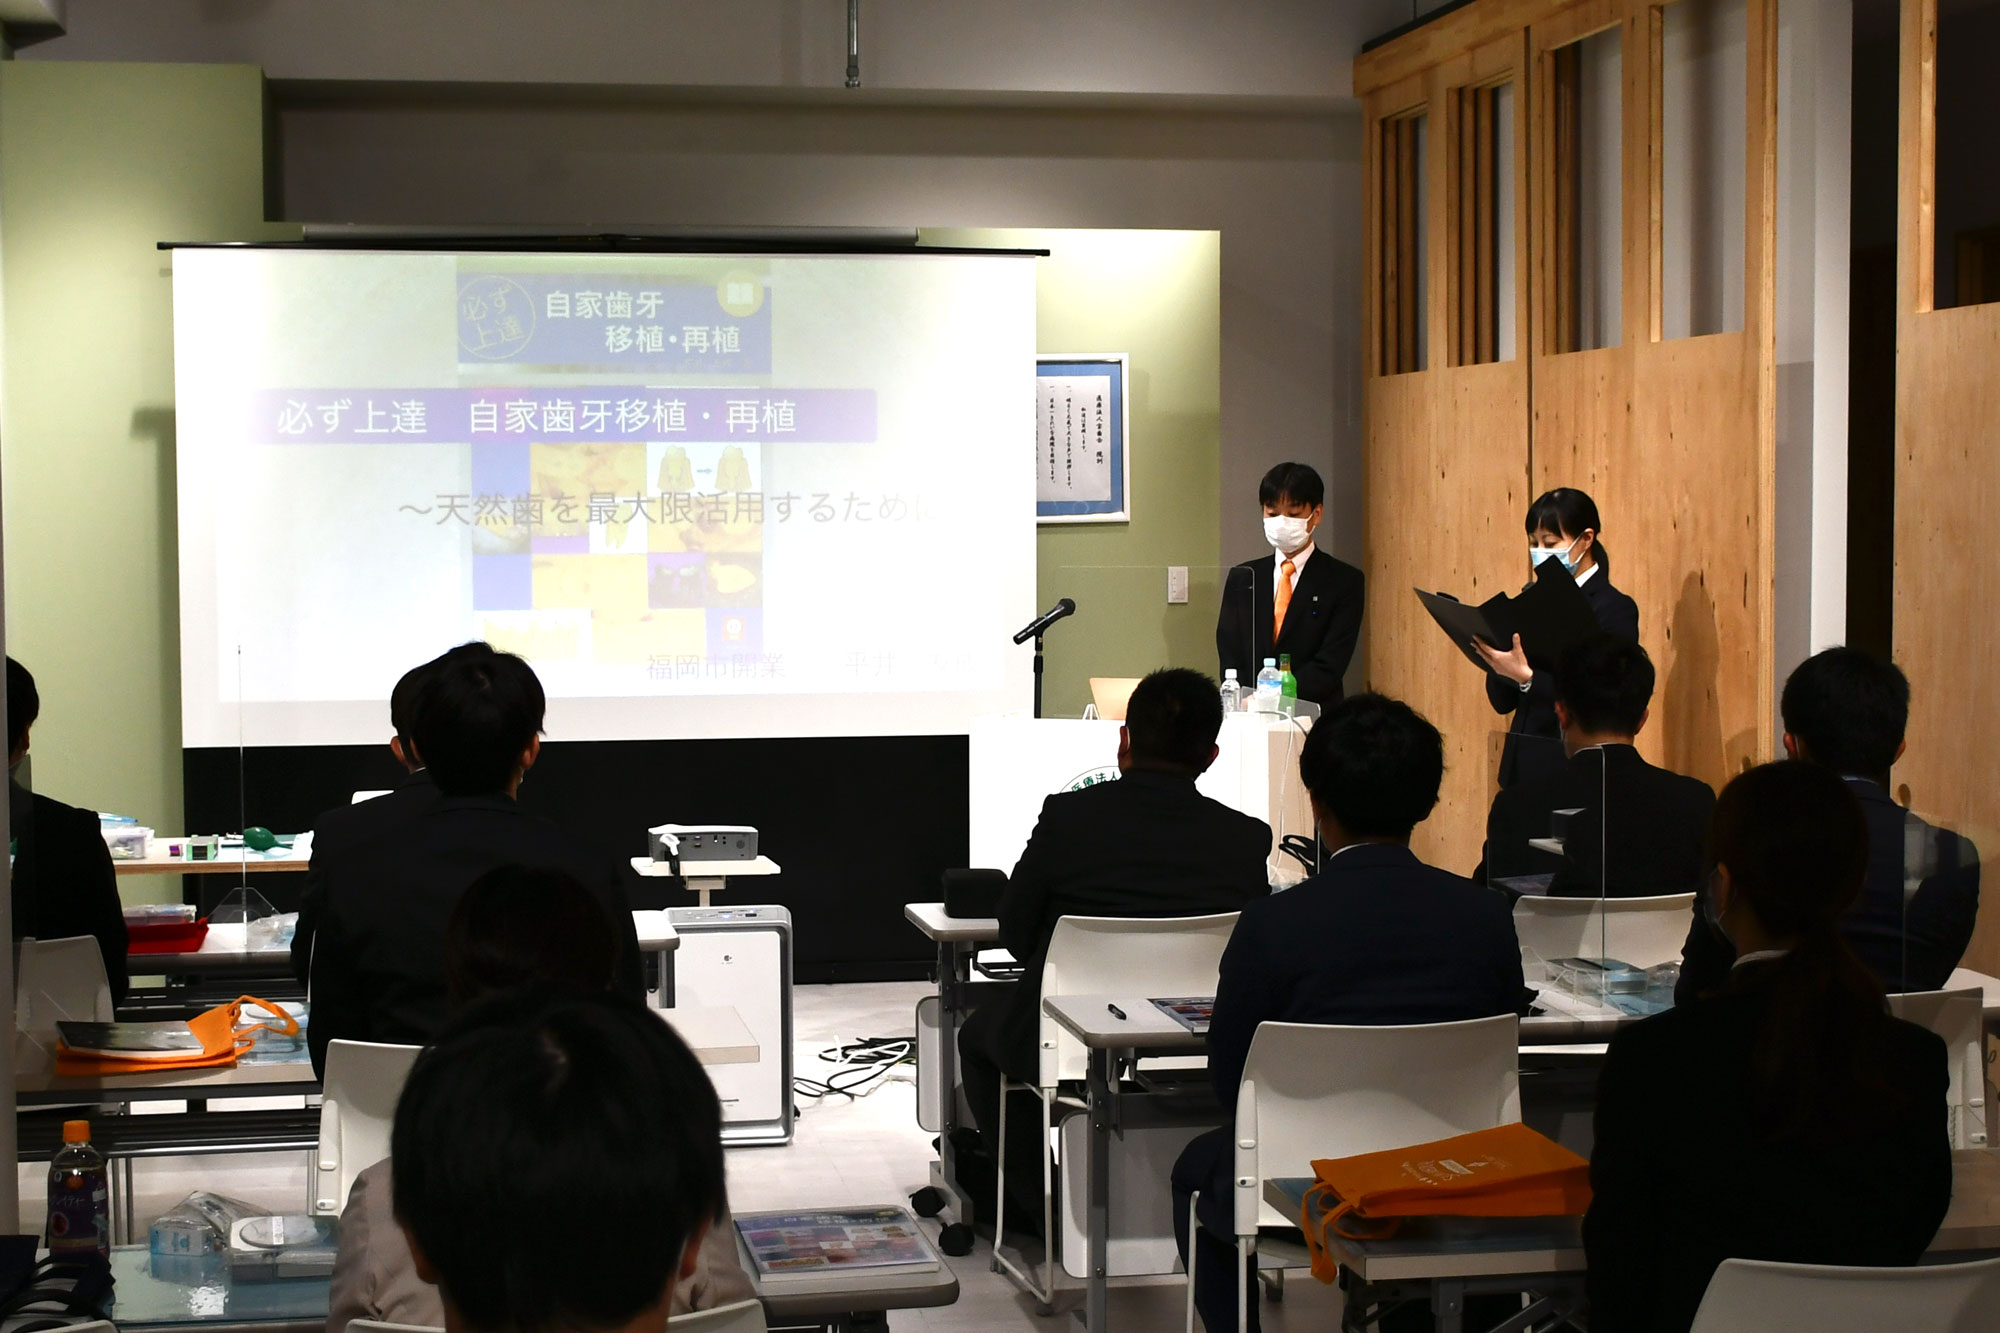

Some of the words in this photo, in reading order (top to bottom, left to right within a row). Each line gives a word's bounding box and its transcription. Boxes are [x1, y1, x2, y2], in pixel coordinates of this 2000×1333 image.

[546, 290, 664, 319] 自家歯牙
[277, 399, 428, 436] 必ず上達
[469, 399, 797, 435] 自家歯牙移植・再植
[646, 653, 786, 681] 福岡市開業
